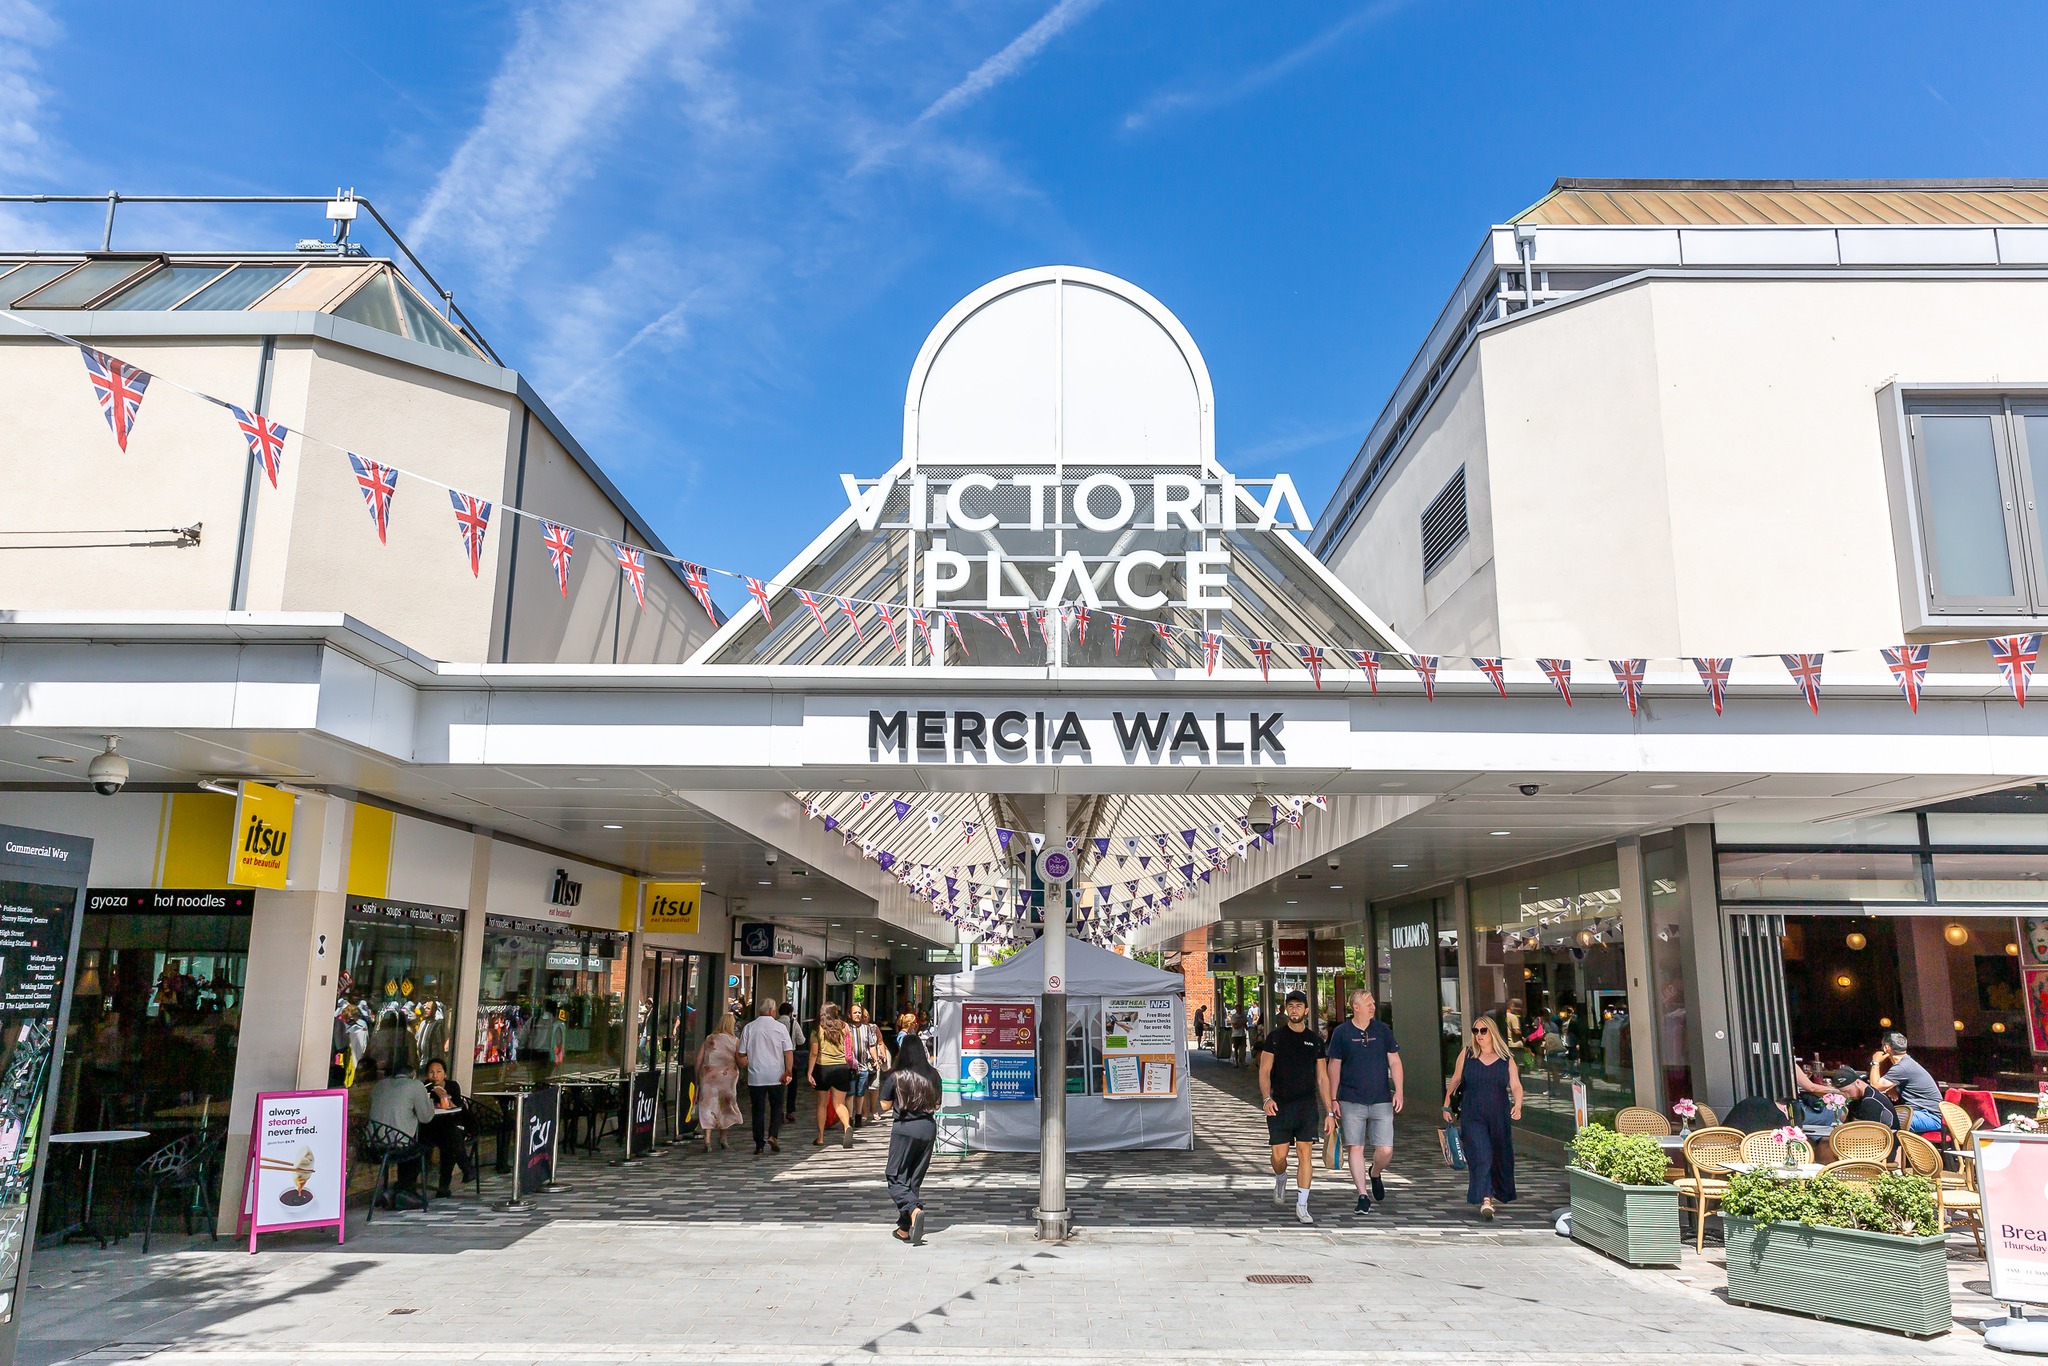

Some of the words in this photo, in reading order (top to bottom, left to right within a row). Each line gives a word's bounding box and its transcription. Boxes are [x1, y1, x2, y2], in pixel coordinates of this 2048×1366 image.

[840, 473, 1313, 532] VICTORIA
[924, 550, 1233, 610] PLACE
[869, 710, 1092, 752] MERCIA
[1112, 710, 1286, 752] WALK
[245, 815, 286, 856] itsu
[6, 842, 51, 857] Commercial
[52, 847, 69, 861] Way
[242, 857, 252, 865] eat
[254, 857, 281, 869] beautiful
[552, 869, 583, 906] itsu
[91, 895, 128, 909] gyoza
[154, 894, 174, 908] hot
[176, 895, 226, 908] noodles
[652, 895, 693, 916] itsu
[362, 903, 377, 914] sushi
[386, 906, 402, 918] soups
[410, 908, 419, 919] rice
[420, 909, 433, 920] bowls
[1392, 922, 1429, 949] LUCIANO'S
[1150, 1000, 1169, 1008] NHS
[268, 1108, 300, 1117] always
[636, 1091, 653, 1123] itsu
[268, 1116, 307, 1126] steamed
[295, 1126, 318, 1135] fried.
[529, 1115, 551, 1156] itsu
[2002, 1224, 2048, 1241] Brea
[2004, 1241, 2047, 1254] Thursday
